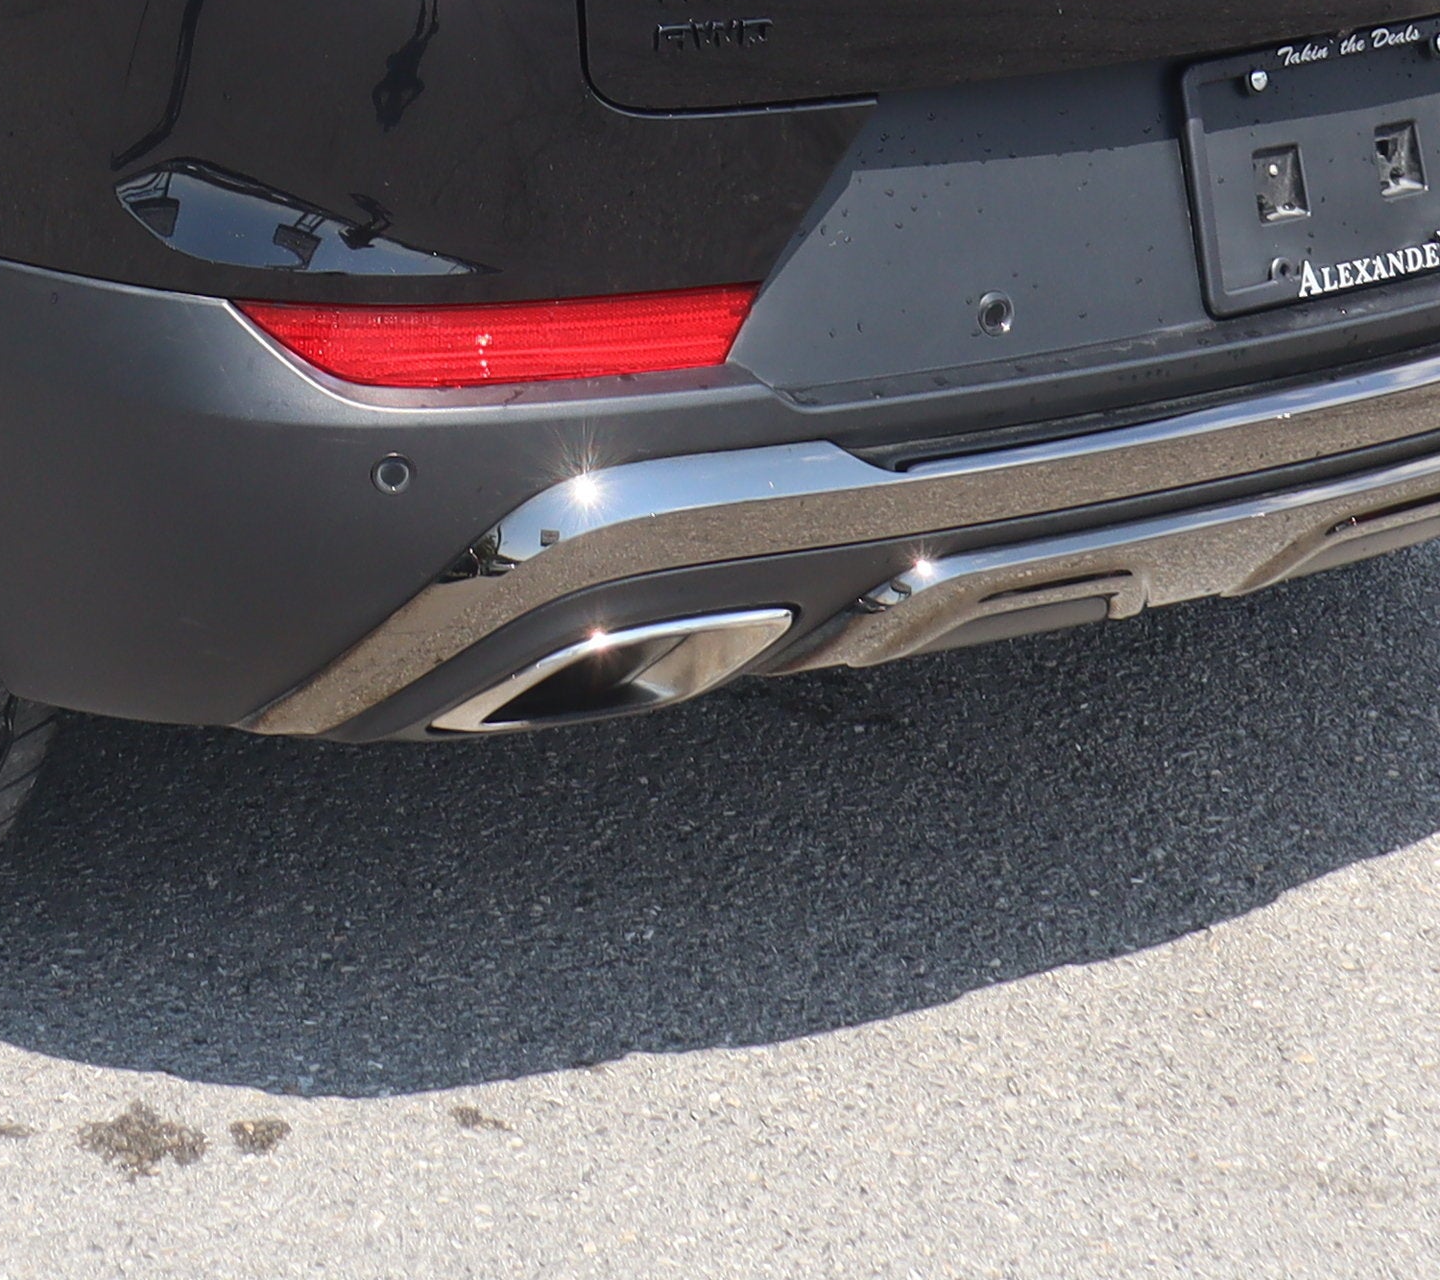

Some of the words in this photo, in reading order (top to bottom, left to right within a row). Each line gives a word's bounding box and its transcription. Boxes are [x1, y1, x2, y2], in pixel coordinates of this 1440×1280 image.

[652, 16, 774, 51] AWD
[1339, 33, 1366, 56] the
[1370, 24, 1421, 50] Deals
